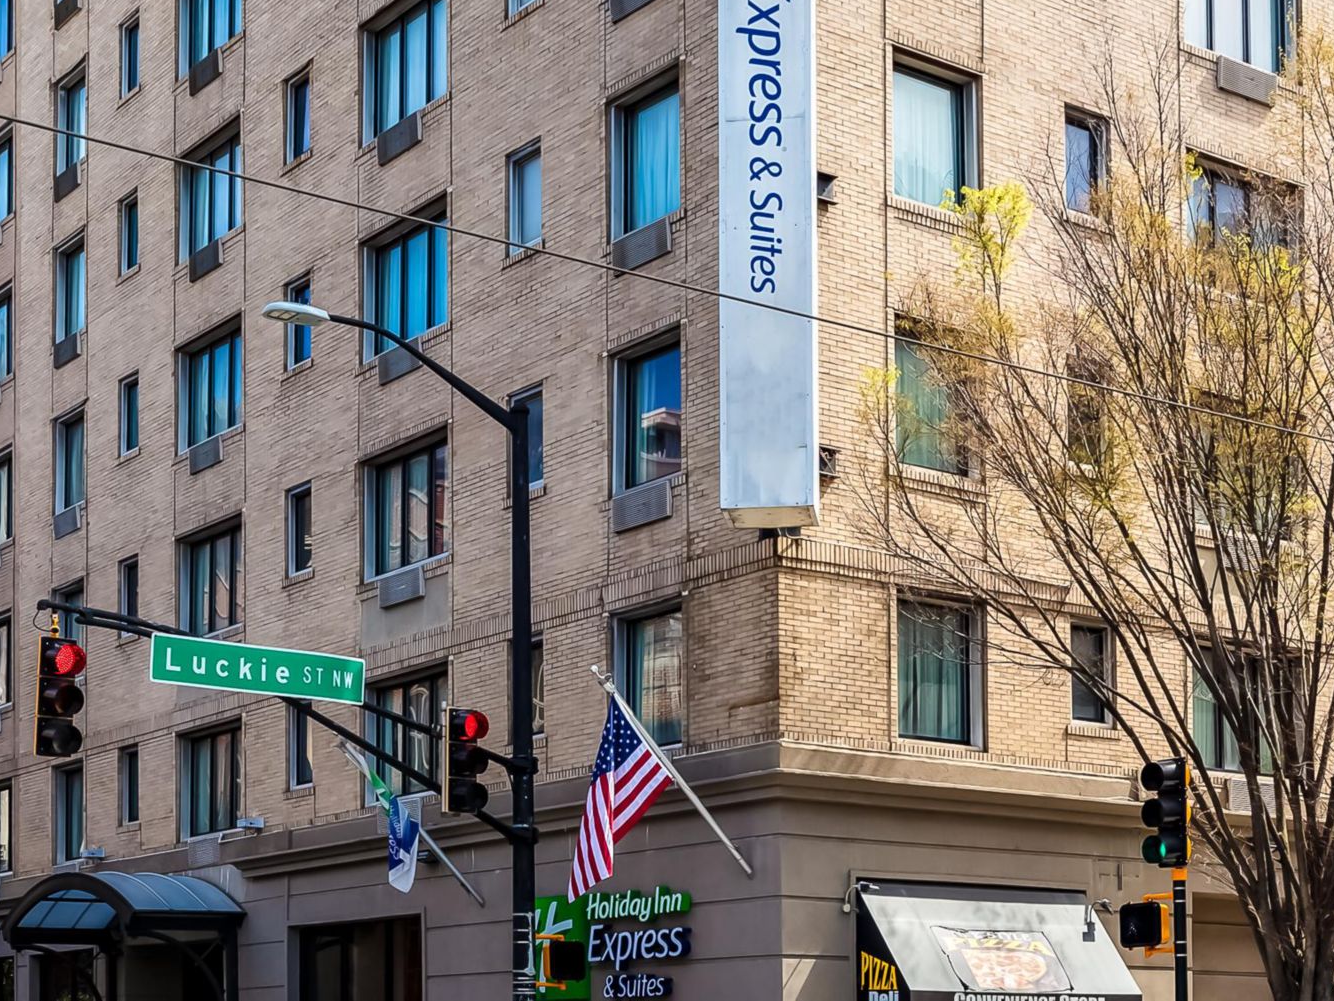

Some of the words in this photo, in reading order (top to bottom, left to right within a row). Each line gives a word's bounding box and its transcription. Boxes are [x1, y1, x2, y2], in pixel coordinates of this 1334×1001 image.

[749, 156, 783, 182] &
[749, 190, 783, 294] Suites
[165, 647, 290, 684] Luckie
[303, 666, 324, 685] ST
[332, 670, 354, 689] NW
[586, 889, 652, 922] Holiday
[654, 886, 682, 914] Inn
[587, 924, 684, 971] Express
[944, 936, 1055, 956] PIZZA
[603, 975, 615, 998] &
[617, 974, 665, 997] Suites
[860, 950, 898, 990] PIZZA
